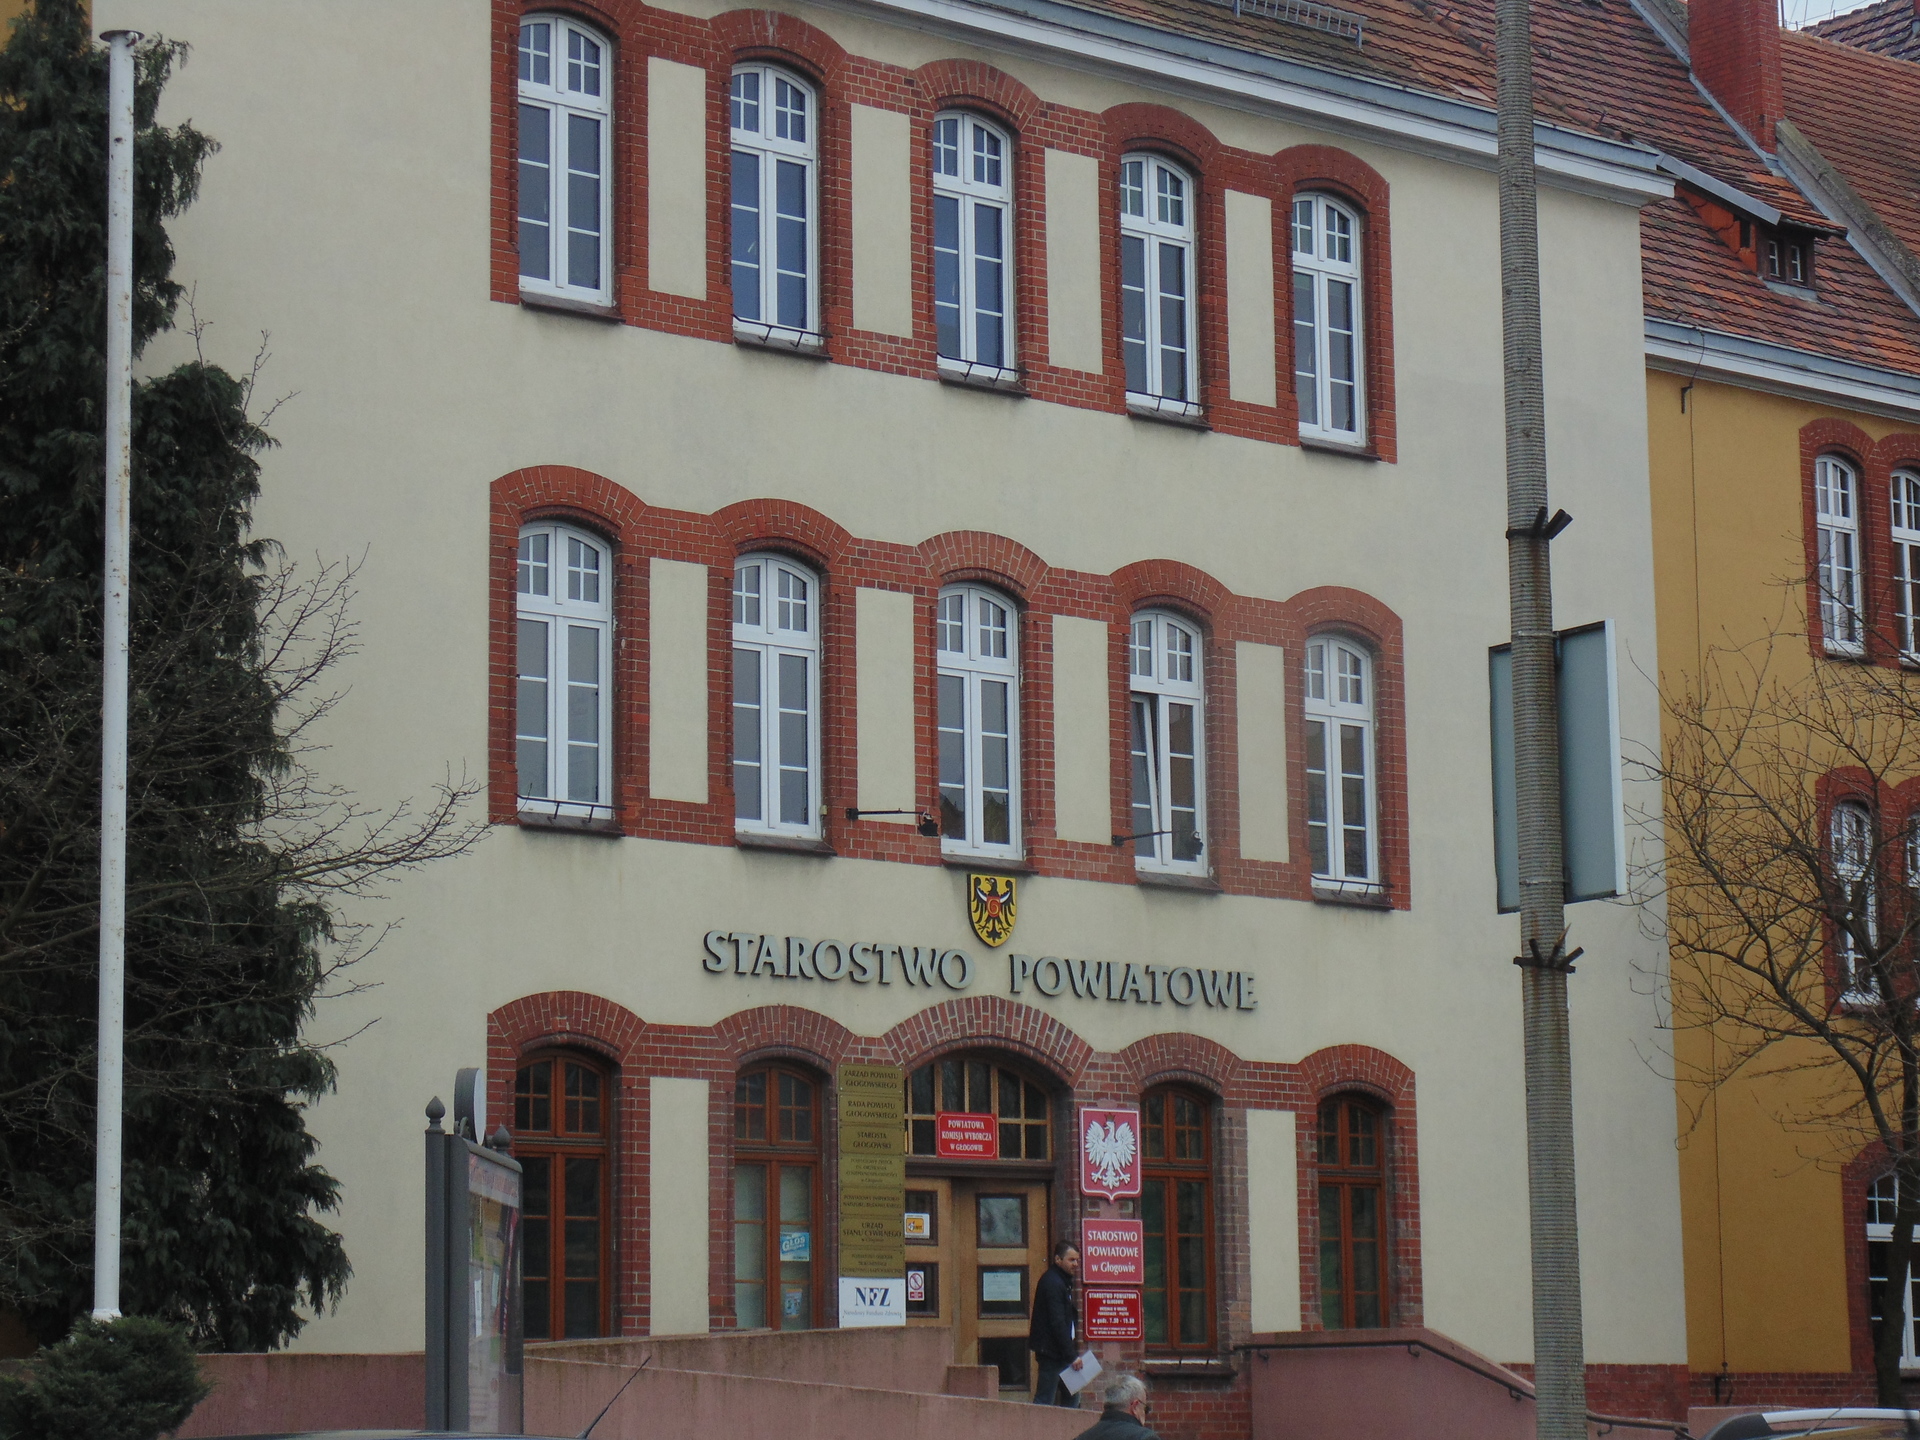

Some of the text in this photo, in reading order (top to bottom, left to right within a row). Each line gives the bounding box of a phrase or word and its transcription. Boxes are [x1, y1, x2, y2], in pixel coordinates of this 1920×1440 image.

[703, 930, 1258, 1009] STAROSTWO POWIATOWE
[870, 1071, 899, 1079] POWIATU
[846, 1080, 897, 1089] GŁOGOWSKIEGO
[846, 1110, 898, 1119] GŁOGOWSKIEGO
[948, 1120, 985, 1129] POWIATOWA
[857, 1131, 887, 1139] STAROSTA
[941, 1131, 992, 1141] KOMISJA WYBORCZA
[853, 1141, 892, 1149] GŁOGOWSKI
[956, 1144, 983, 1152] GŁOGOWIE
[861, 1222, 884, 1230] URZĄD
[843, 1229, 864, 1237] STANU
[865, 1230, 901, 1238] CYWILNEGO
[1087, 1230, 1138, 1242] STAROSTWO
[1087, 1246, 1139, 1257] POWIATOWE
[1092, 1261, 1136, 1275] w Głogowie
[855, 1287, 890, 1306] NFZ
